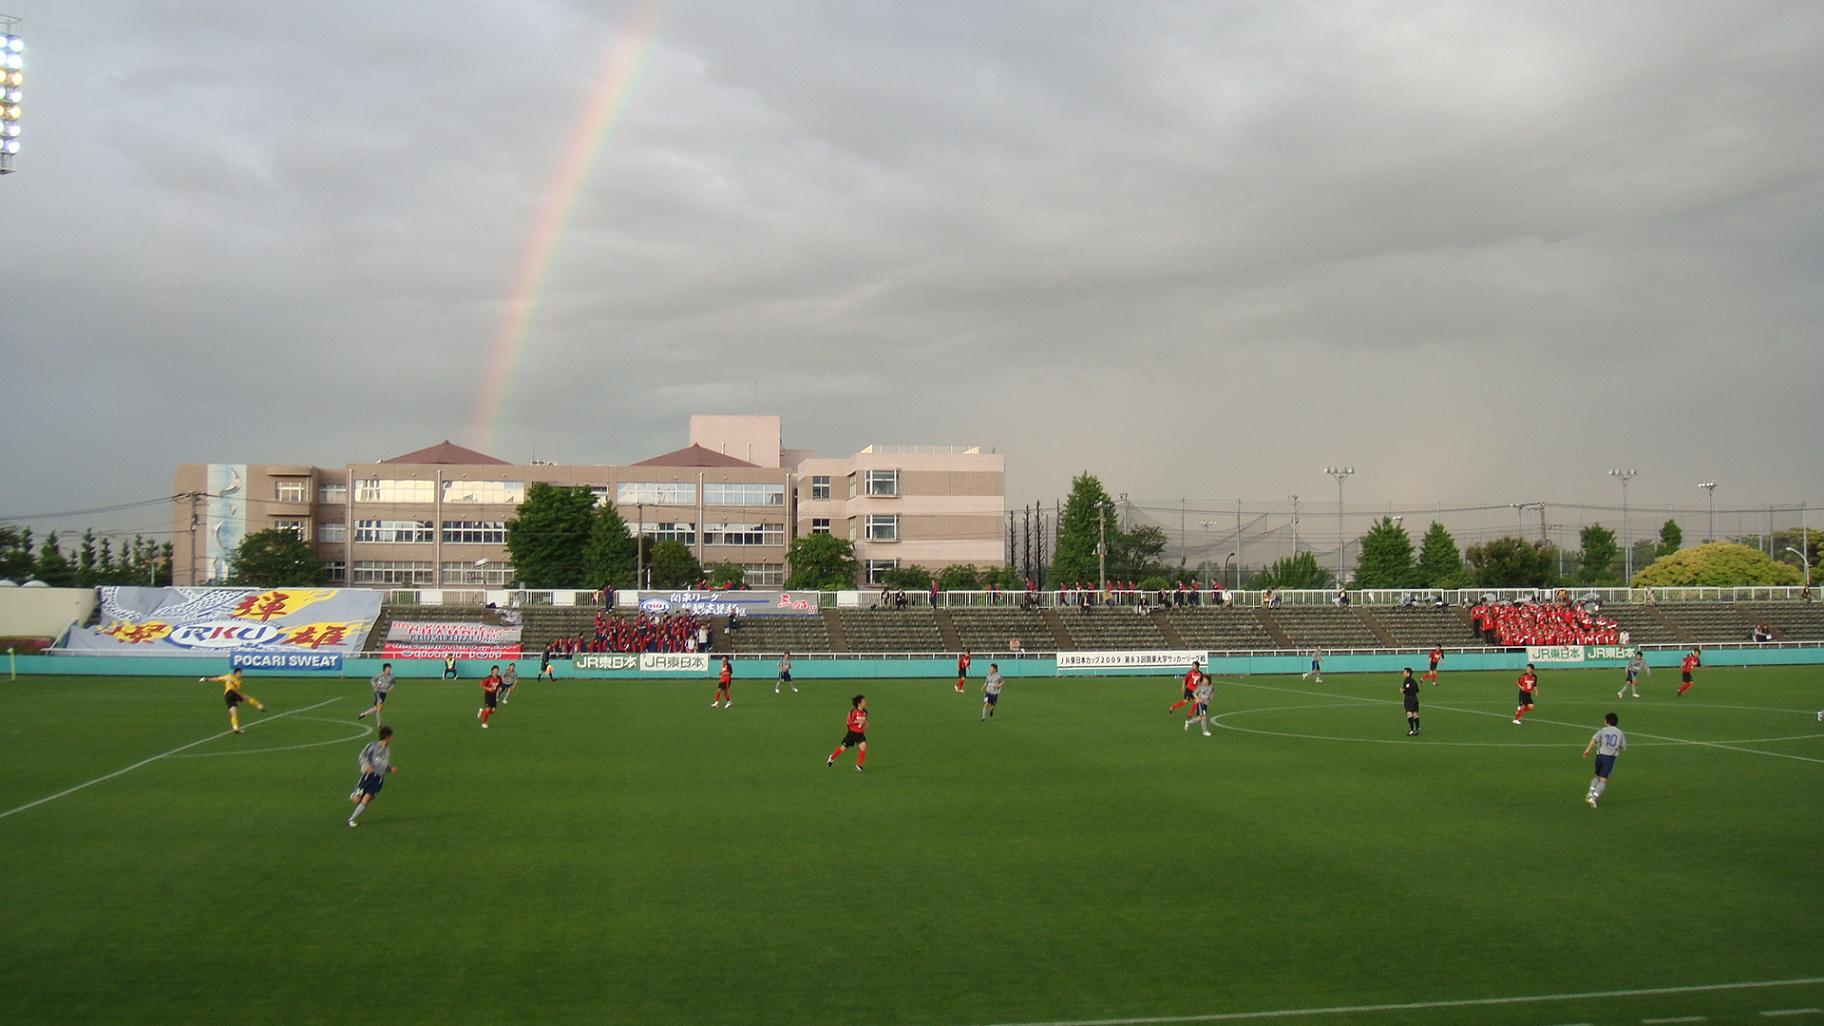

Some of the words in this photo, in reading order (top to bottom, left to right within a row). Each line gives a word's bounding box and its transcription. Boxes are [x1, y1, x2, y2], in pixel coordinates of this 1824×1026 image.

[181, 626, 267, 641] RKU
[1533, 648, 1580, 659] JR東日本
[1588, 647, 1635, 659] JR東日本
[233, 655, 285, 667] POCARI
[288, 655, 338, 667] SWEAT
[576, 655, 637, 669] JR東日本
[645, 655, 704, 669] JR東日本
[1604, 734, 1617, 748] 10
